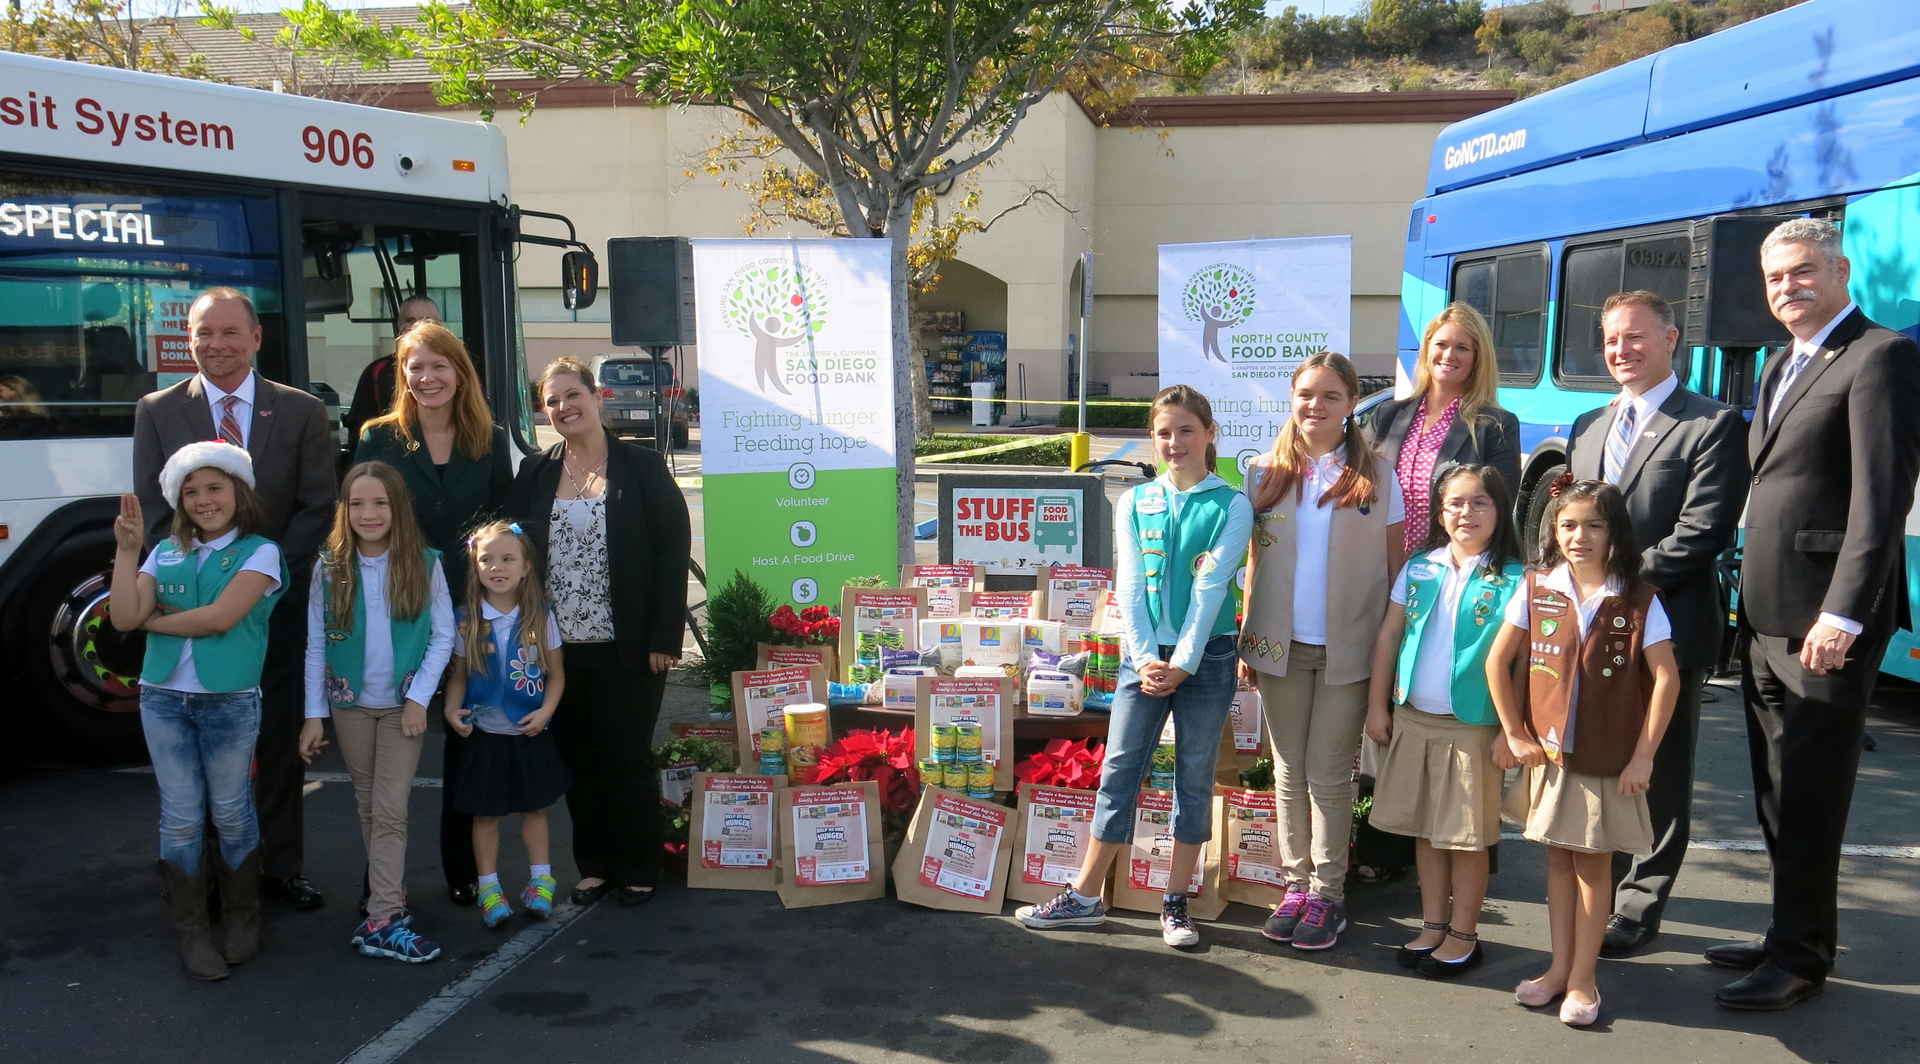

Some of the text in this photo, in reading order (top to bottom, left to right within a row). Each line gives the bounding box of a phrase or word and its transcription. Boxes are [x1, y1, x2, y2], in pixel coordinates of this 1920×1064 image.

[0, 91, 234, 150] sit System
[302, 125, 374, 169] 906
[1445, 128, 1527, 170] GoNCTD.com
[0, 203, 164, 246] SPECIAL
[719, 257, 828, 329] SERVING SAN DIEGO COUNTY SINCE 1977
[1182, 263, 1257, 322] SERVING SAN DIEGO COUNTY SINCE 1977
[160, 302, 191, 316] STU
[1232, 333, 1328, 343] NORTH COUNTY
[1232, 345, 1328, 358] FOOD BANK
[785, 358, 876, 371] SAN DIEGO
[785, 372, 876, 385] FOOD BANK
[722, 409, 877, 432] Fighting hunger
[734, 433, 867, 455] Feeding hope
[775, 497, 829, 507] Volunteer
[957, 497, 1035, 520] STUFF
[958, 522, 1031, 542] THE BUS
[752, 552, 855, 566] Host A Food Drive
[1068, 603, 1091, 611] HUNGER
[725, 820, 751, 828] HUNGER
[817, 833, 844, 841] HUNGER
[1049, 835, 1075, 845] HUNGER
[1242, 835, 1270, 845] HUNGER
[949, 842, 974, 855] HUNGER
